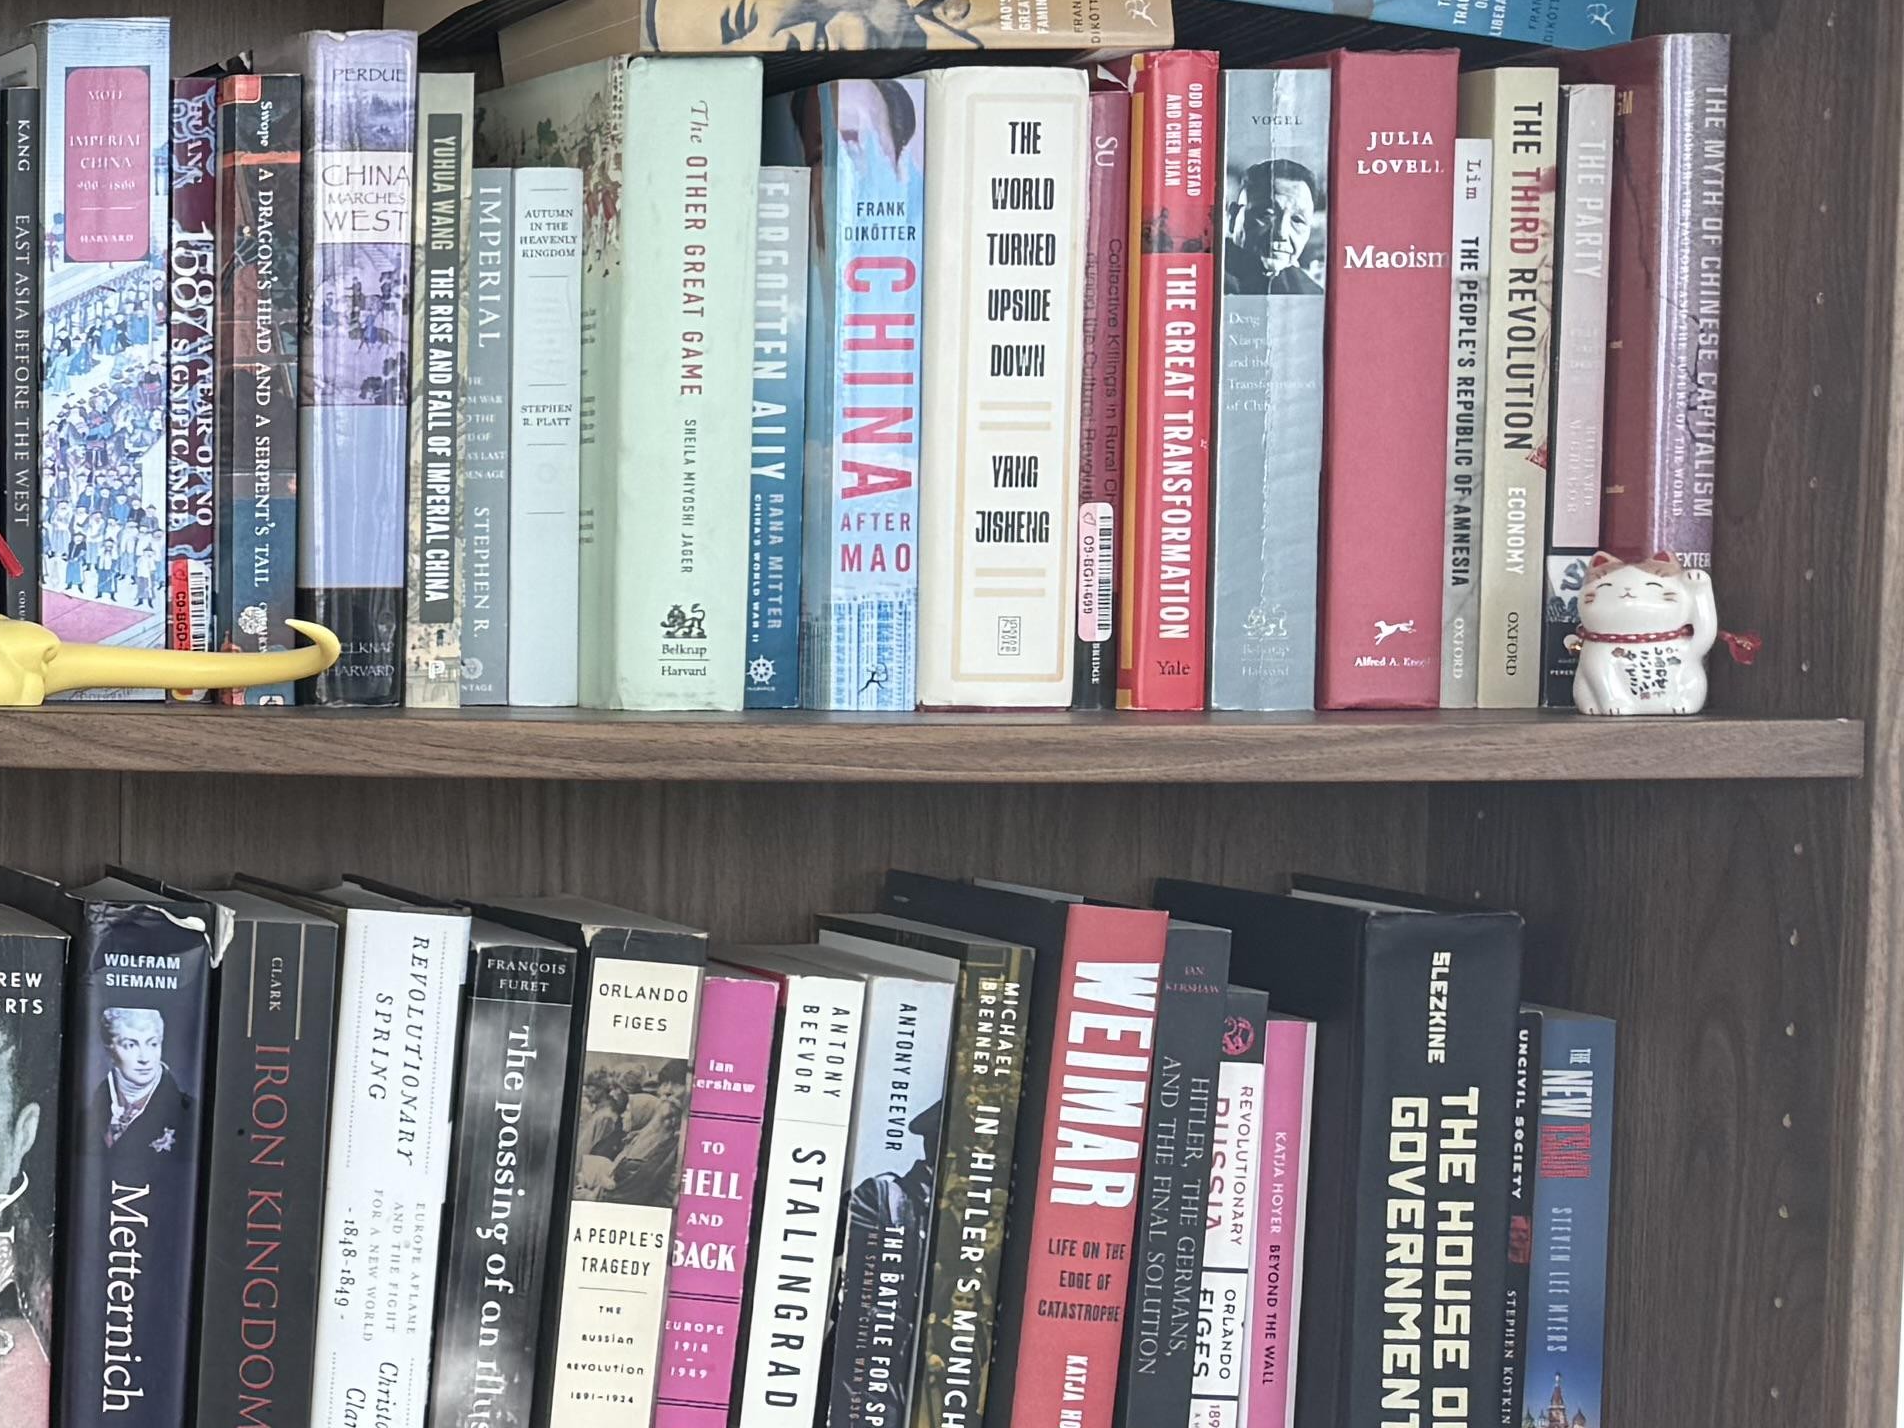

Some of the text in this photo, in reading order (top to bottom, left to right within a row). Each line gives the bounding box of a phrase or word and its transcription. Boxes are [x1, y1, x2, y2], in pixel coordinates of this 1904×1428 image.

[332, 66, 406, 85] PERDUE
[1008, 121, 1041, 156] THE
[1367, 129, 1434, 150] JULIA
[321, 162, 411, 189] CHINA
[1357, 157, 1445, 177] LOVELL
[327, 190, 407, 206] MARCHES
[991, 177, 1054, 211] WORLD
[324, 207, 409, 234] WEST
[856, 201, 905, 219] FRANK
[844, 220, 916, 242] DIKÖTTER
[986, 232, 1056, 267] TURNED
[987, 287, 1050, 323] UPSIDE
[990, 343, 1045, 379] DOWN
[839, 253, 915, 501] CHINA
[991, 454, 1038, 490] YANG
[841, 511, 911, 534] AFTER
[975, 509, 1049, 546] JISHENG
[840, 542, 911, 573] MAO
[104, 952, 182, 971] WOLFRAM
[105, 971, 179, 990] SIEMANN
[599, 983, 690, 1004] ORLANDO
[613, 1014, 668, 1032] FIGES
[1427, 951, 1451, 1064] SLEZKINE
[1048, 960, 1162, 1209] WEIMAR
[672, 1240, 737, 1273] BACK
[764, 1146, 827, 1411] STALINGRAD
[103, 1179, 149, 1414] Metternich
